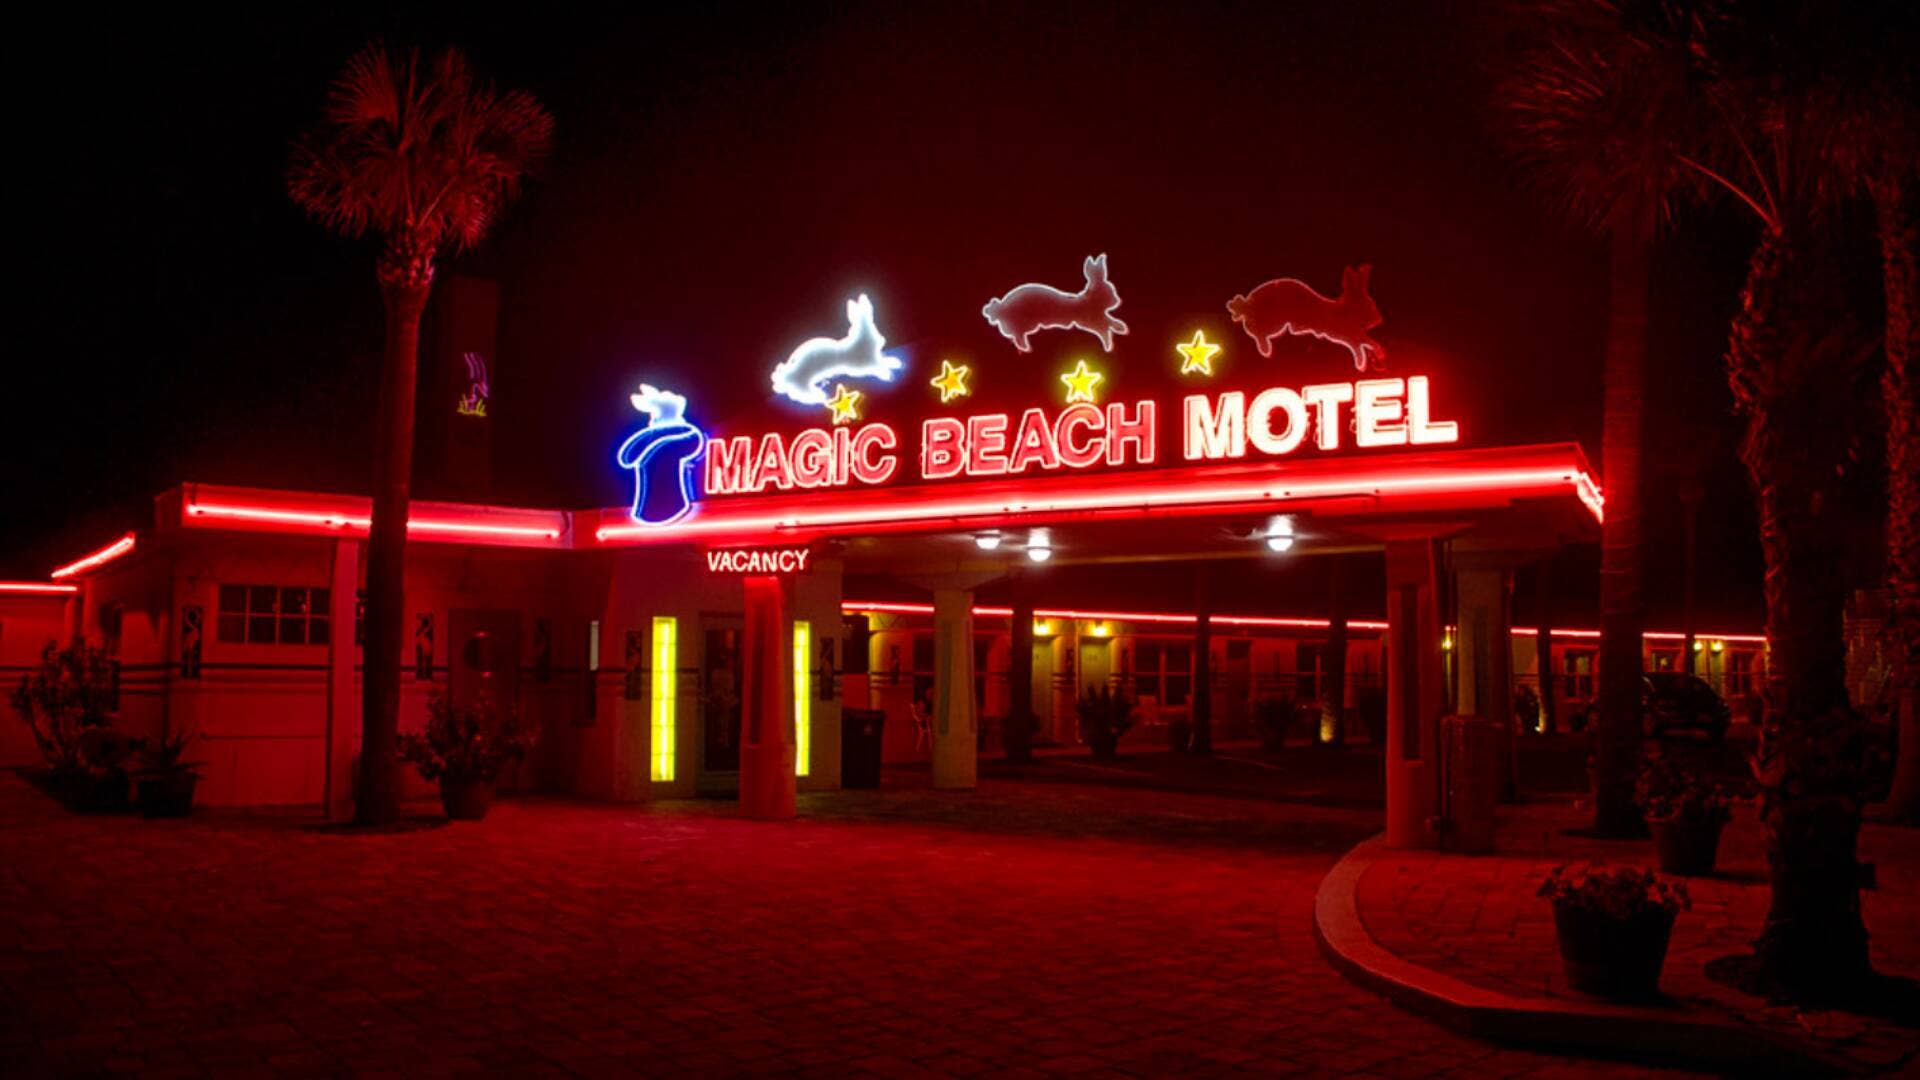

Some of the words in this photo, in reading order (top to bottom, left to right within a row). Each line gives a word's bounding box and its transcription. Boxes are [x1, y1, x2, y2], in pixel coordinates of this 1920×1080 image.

[704, 423, 896, 494] MAGIC
[921, 400, 1156, 479] BEACH
[1183, 375, 1459, 460] MOTEL
[706, 548, 809, 573] VACANCY
